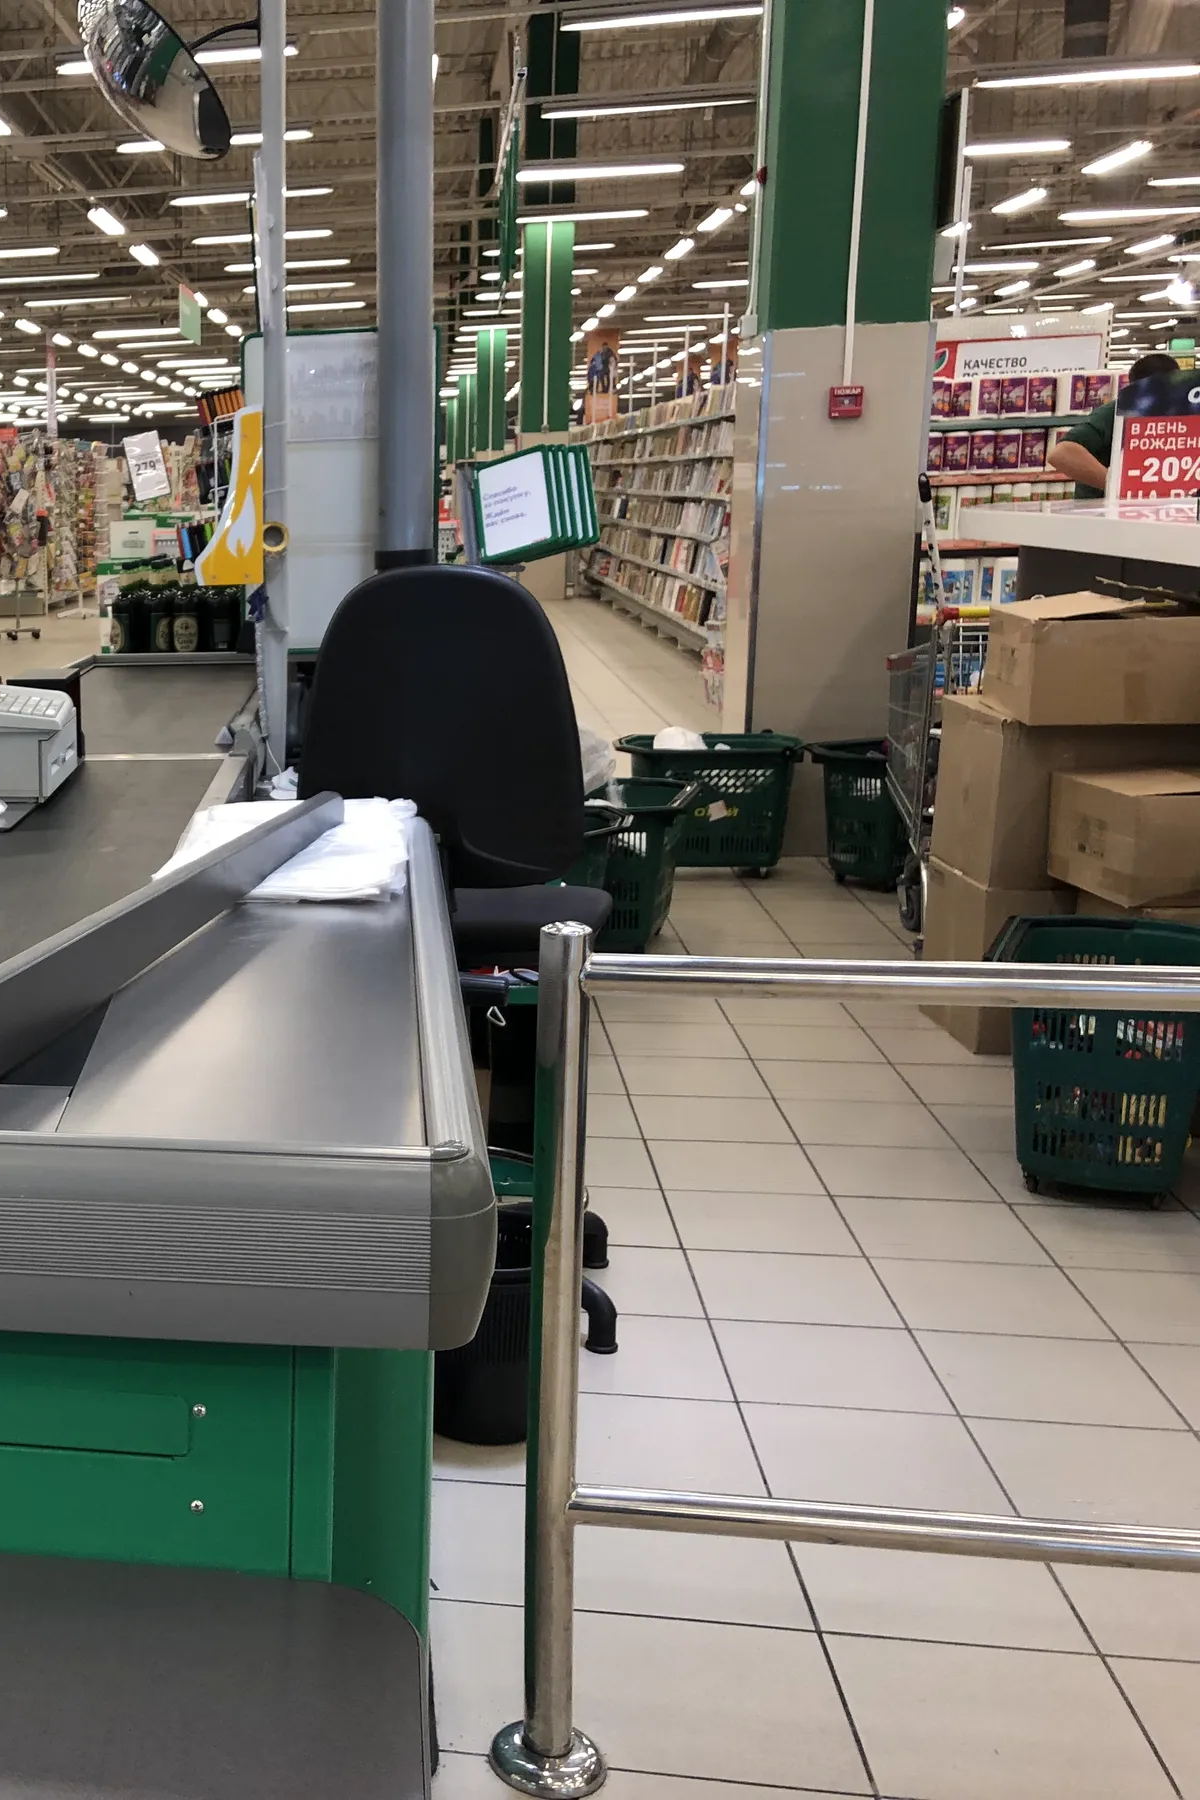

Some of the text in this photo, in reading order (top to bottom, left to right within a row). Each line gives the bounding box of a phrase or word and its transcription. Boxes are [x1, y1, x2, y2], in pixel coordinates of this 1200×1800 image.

[963, 357, 1028, 370] КАЧЕСТВО
[1131, 422, 1187, 436] В ДЕНЬ
[1129, 437, 1200, 451] РОЖДЕН
[1128, 456, 1200, 483] -20%
